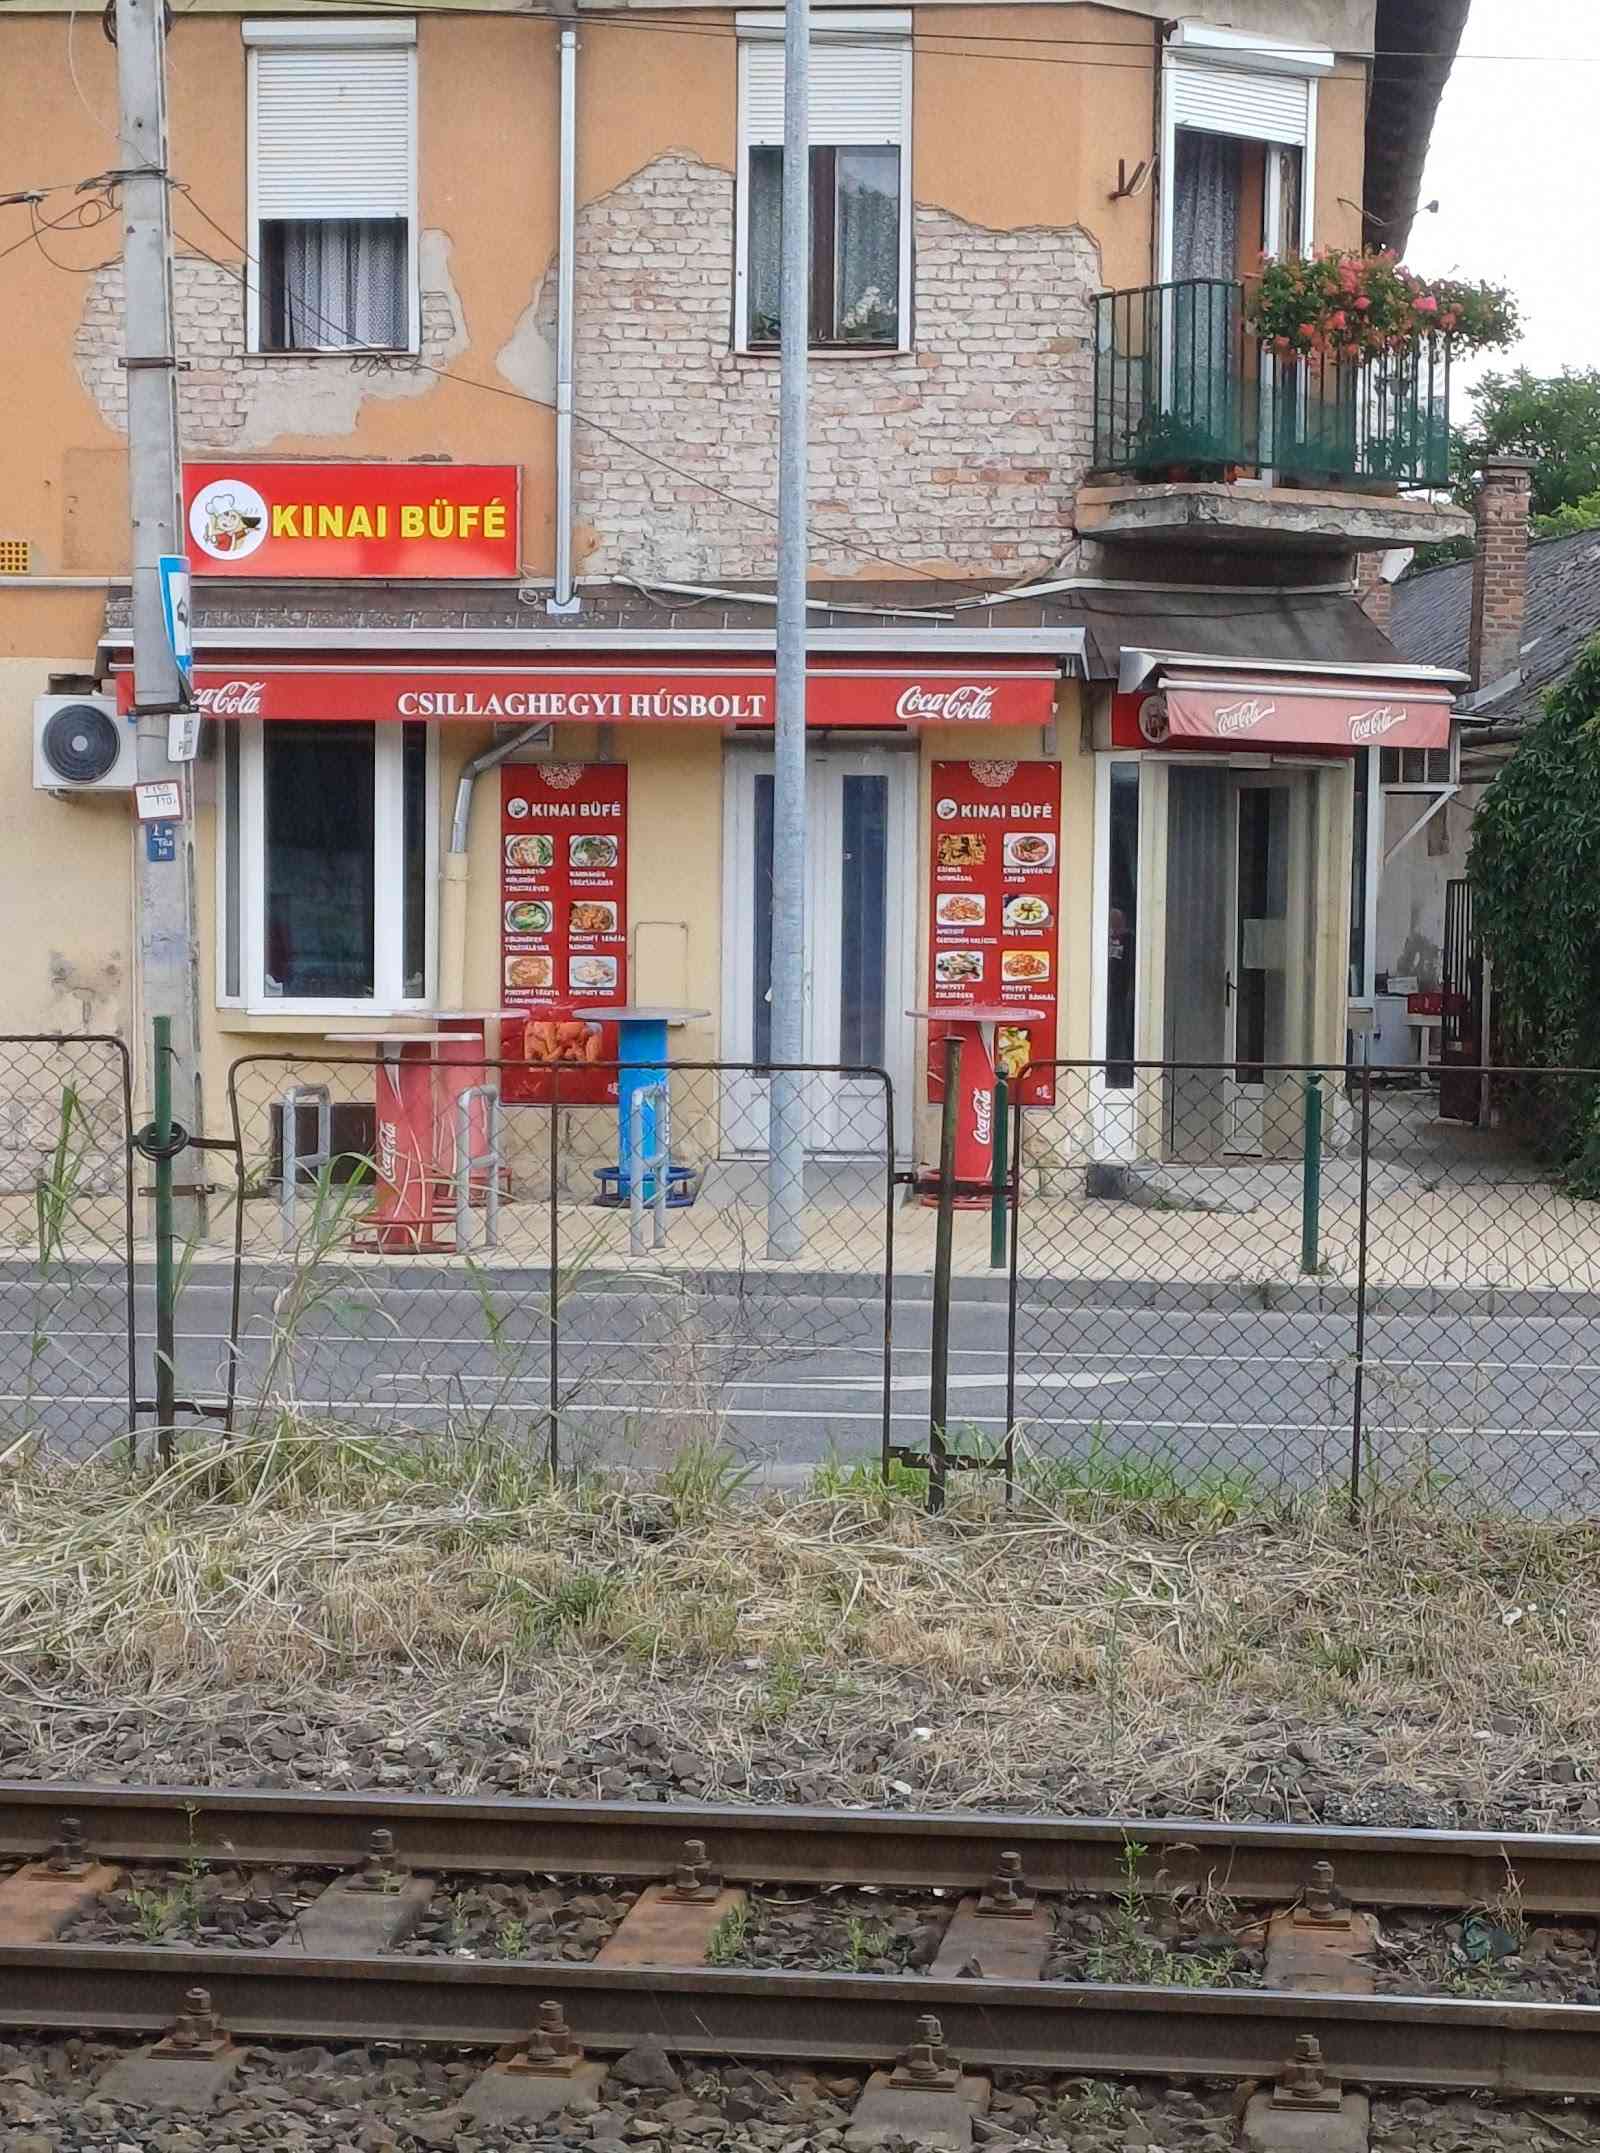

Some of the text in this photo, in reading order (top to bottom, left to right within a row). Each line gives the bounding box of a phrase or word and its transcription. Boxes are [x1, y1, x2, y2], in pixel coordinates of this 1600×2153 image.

[271, 497, 506, 538] KINAI BÜFÉ
[397, 688, 766, 717] CSILLAGHEGYI HÚSBOLT
[896, 685, 1000, 719] Coca-Cola
[531, 801, 621, 817] KINAI BÜFÉ
[961, 803, 1053, 818] KINAI BÜFÉ
